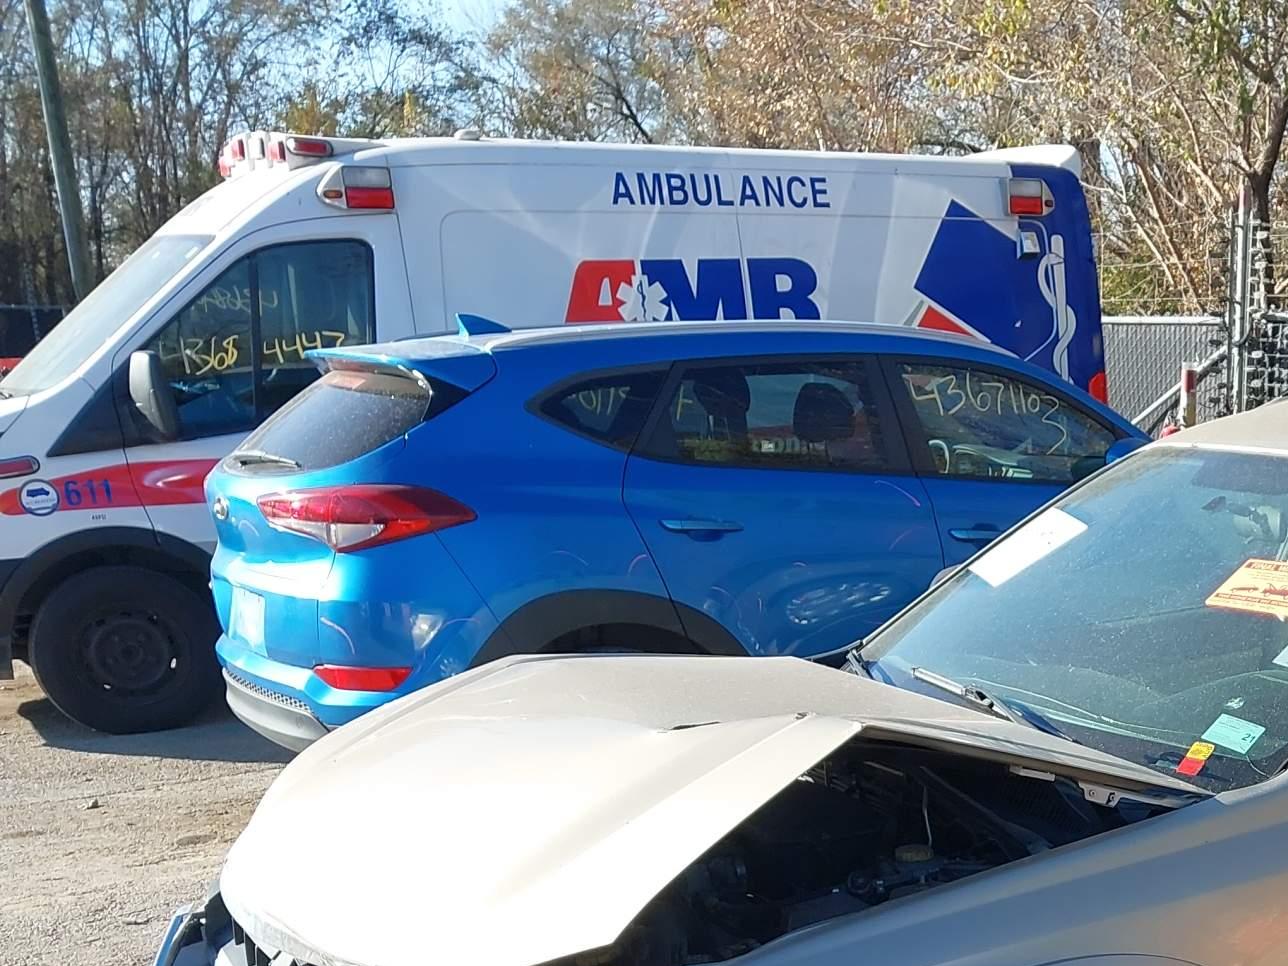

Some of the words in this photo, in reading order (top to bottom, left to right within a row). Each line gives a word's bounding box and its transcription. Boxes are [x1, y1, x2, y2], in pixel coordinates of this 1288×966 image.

[612, 172, 831, 208] AMBULANCE
[565, 257, 822, 323] AMR
[64, 479, 113, 506] 611
